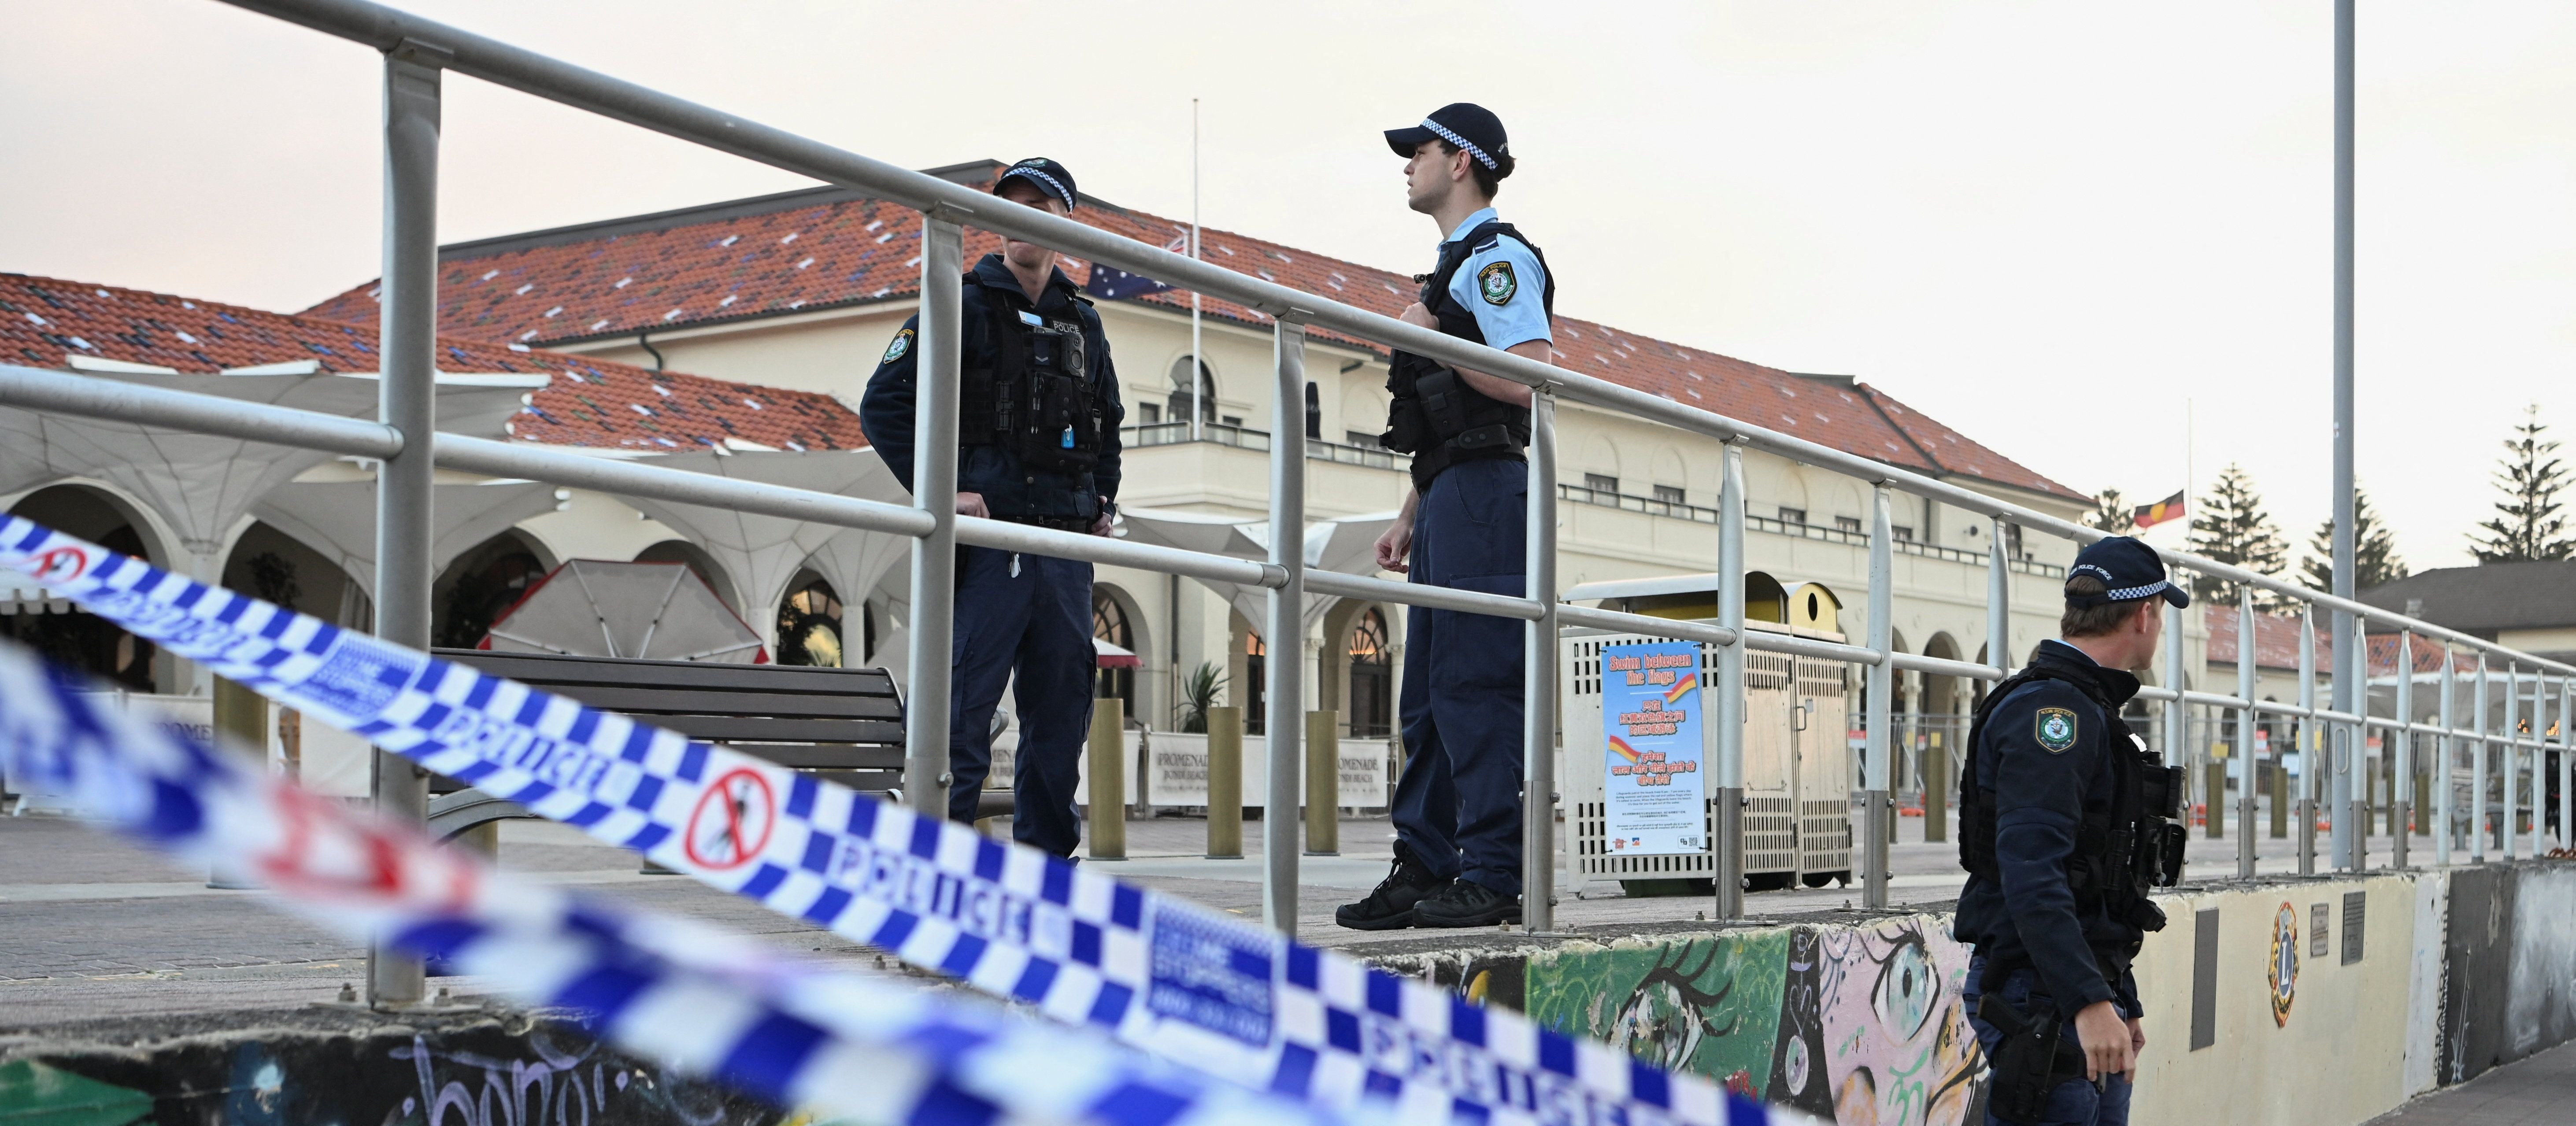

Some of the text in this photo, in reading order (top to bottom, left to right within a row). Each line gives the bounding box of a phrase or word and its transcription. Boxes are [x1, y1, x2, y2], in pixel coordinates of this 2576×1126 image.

[1054, 323, 1081, 334] POLICE
[2095, 567, 2113, 580] FORCE
[1609, 653, 1692, 671] Swim between
[1626, 669, 1676, 686] the flags
[1642, 700, 1662, 712] 只在
[1619, 710, 1685, 724] 红黄双色旗之间
[2054, 709, 2072, 717] POLICE
[1629, 724, 1677, 736] 的区域游泳
[438, 709, 611, 792] POLICE
[1641, 750, 1665, 763] हमेशा
[1338, 758, 1378, 770] OMENADE
[1353, 774, 1373, 783] BEACH
[837, 836, 1033, 945] POLICE
[2280, 941, 2289, 986] L
